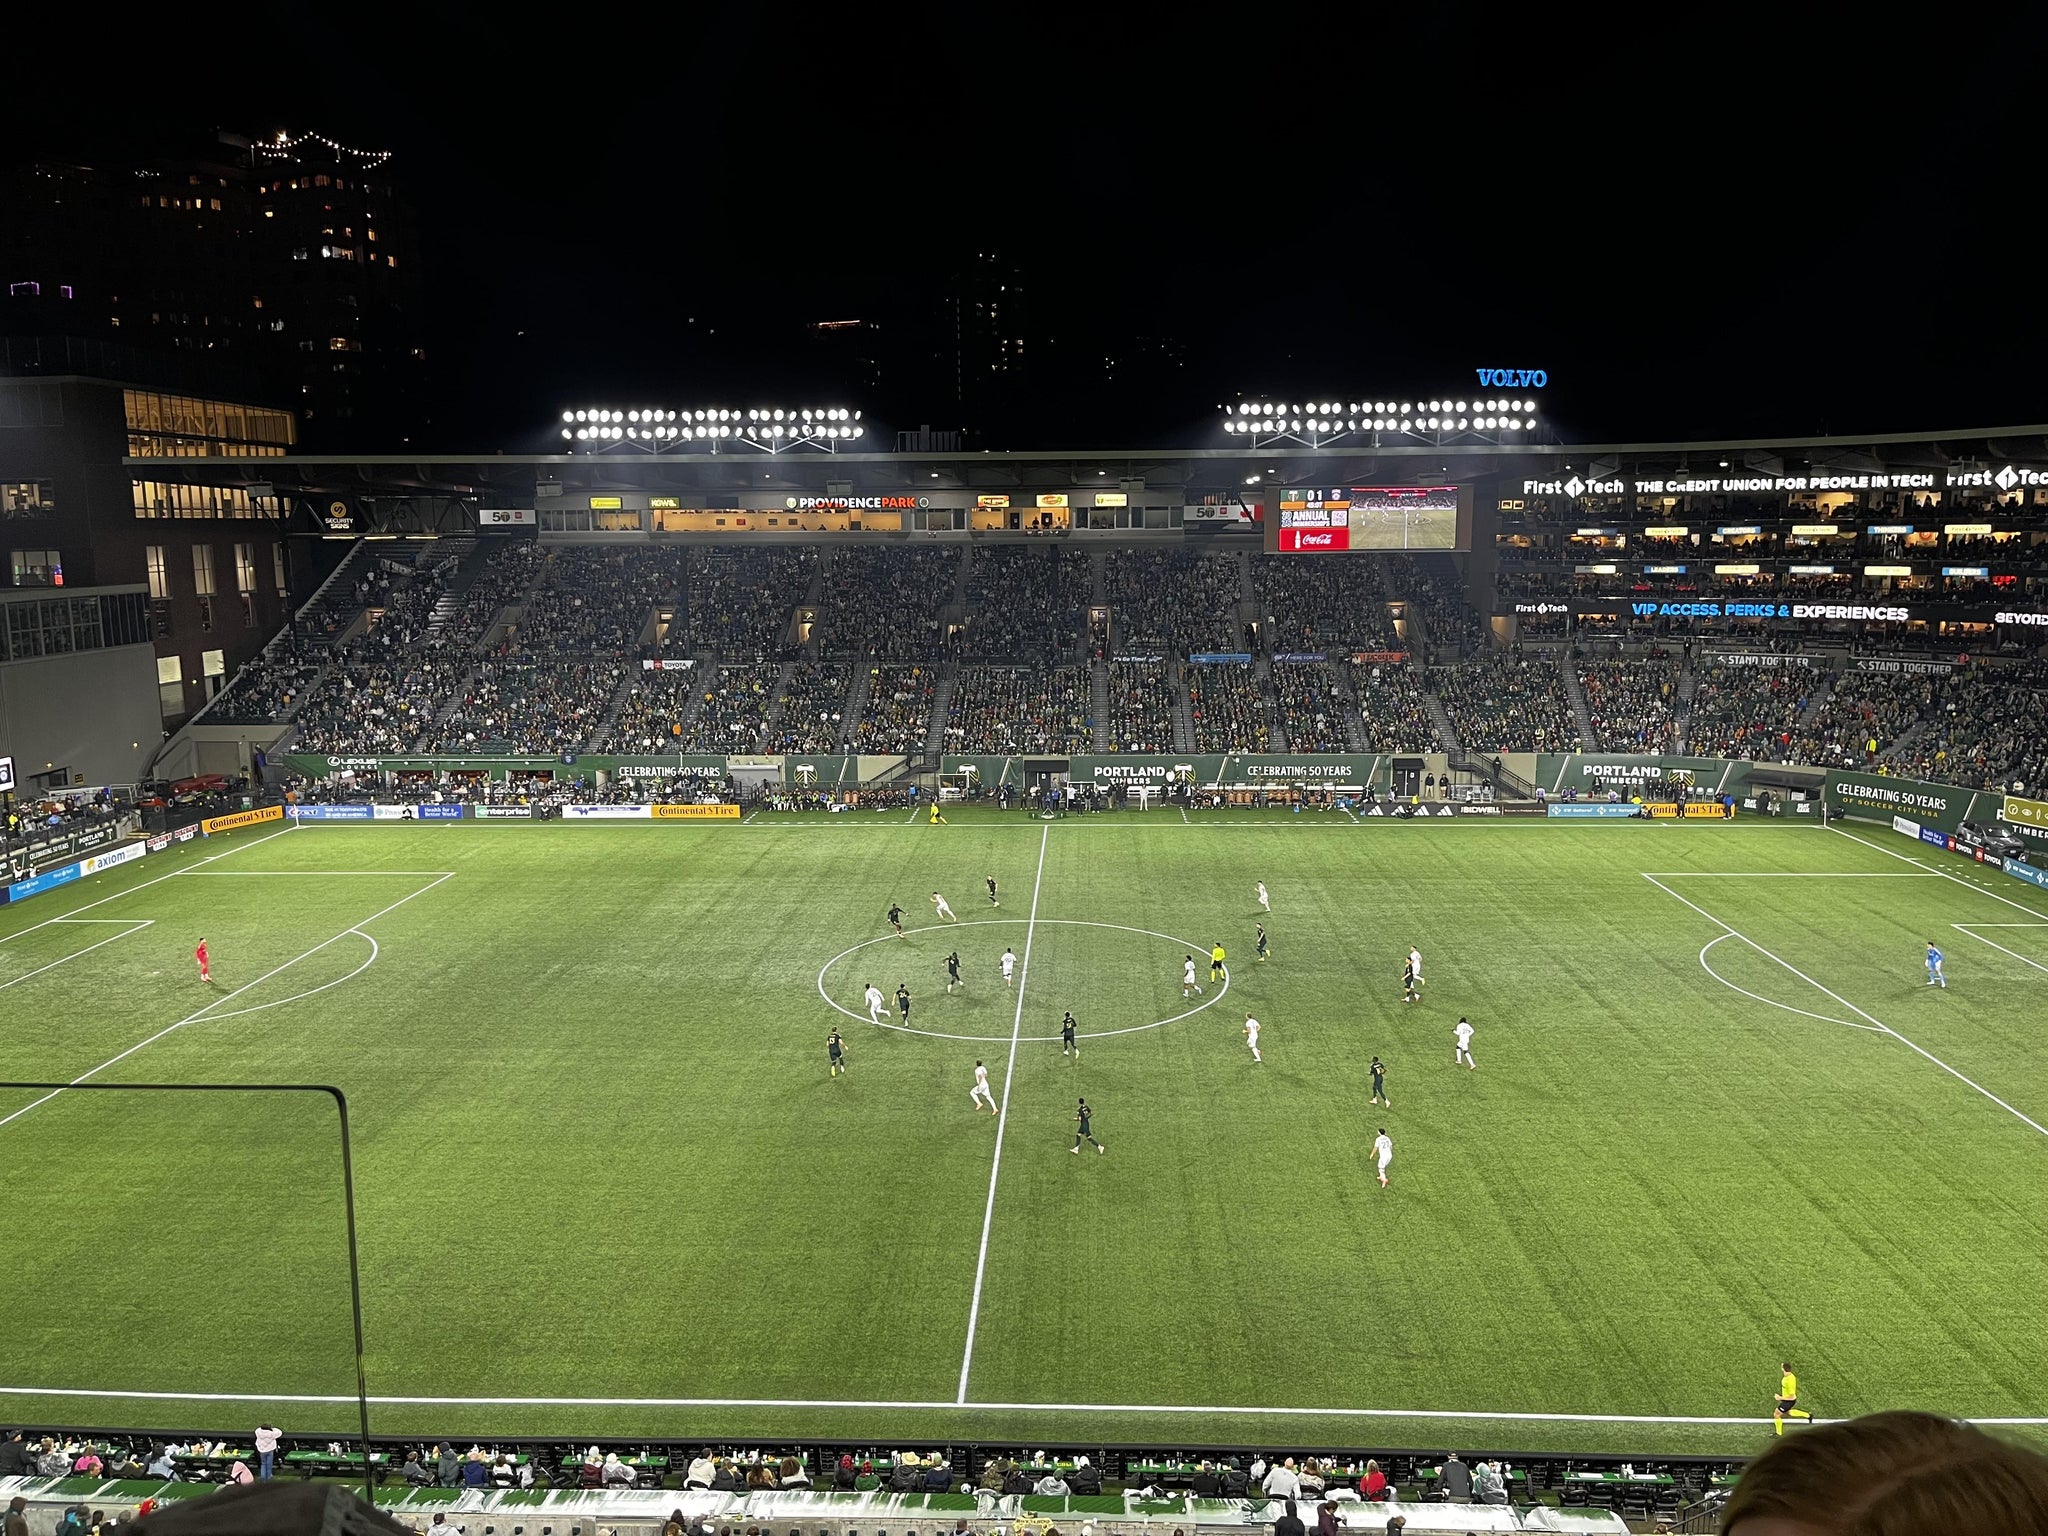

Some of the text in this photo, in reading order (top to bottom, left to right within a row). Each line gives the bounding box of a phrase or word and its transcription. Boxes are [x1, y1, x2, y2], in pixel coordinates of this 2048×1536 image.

[1476, 369, 1547, 387] VOLVO
[1523, 479, 1624, 494] First Tech
[1635, 481, 1664, 493] THE
[1722, 478, 1773, 491] UNION
[1775, 477, 1806, 490] FOR
[1809, 476, 1869, 490] PEOPLE
[1871, 475, 1889, 488] IN
[1891, 474, 1933, 487] TECH
[1307, 490, 1322, 501] 0 1
[1293, 510, 1330, 520] ANNUAL
[1515, 603, 1568, 613] First Tech
[1632, 603, 1909, 621] VIP ACCESS, PERKS & EXPERIENCES
[1728, 655, 1758, 665] STAND
[1868, 661, 1952, 675] STAND TOGETHER
[619, 766, 677, 777] CELEBRATING
[691, 767, 720, 777] YEARS
[1094, 766, 1165, 777] PORTLAND
[1247, 766, 1352, 776] CELEBRATING 50 YEARS
[1583, 765, 1662, 778] PORTLAND
[1599, 777, 1645, 785] TIMBERS
[1836, 783, 1947, 810] CELEBRATING 50 YEARS
[477, 807, 530, 818] enterprise
[659, 806, 734, 816] Continental Tire
[1463, 806, 1501, 814] BIDWELL
[1857, 799, 1893, 810] SOCCER
[1897, 805, 1917, 814] CITY
[1921, 810, 1939, 818] USA
[209, 809, 277, 830] Continental Tire
[78, 831, 104, 845] PORTLAND
[174, 824, 199, 839] DISCOUNT
[147, 833, 172, 848] DISCOUNT
[1956, 843, 1973, 855] TOYOTA
[97, 850, 126, 869] axiom
[1984, 853, 2001, 866] TOYOTA
